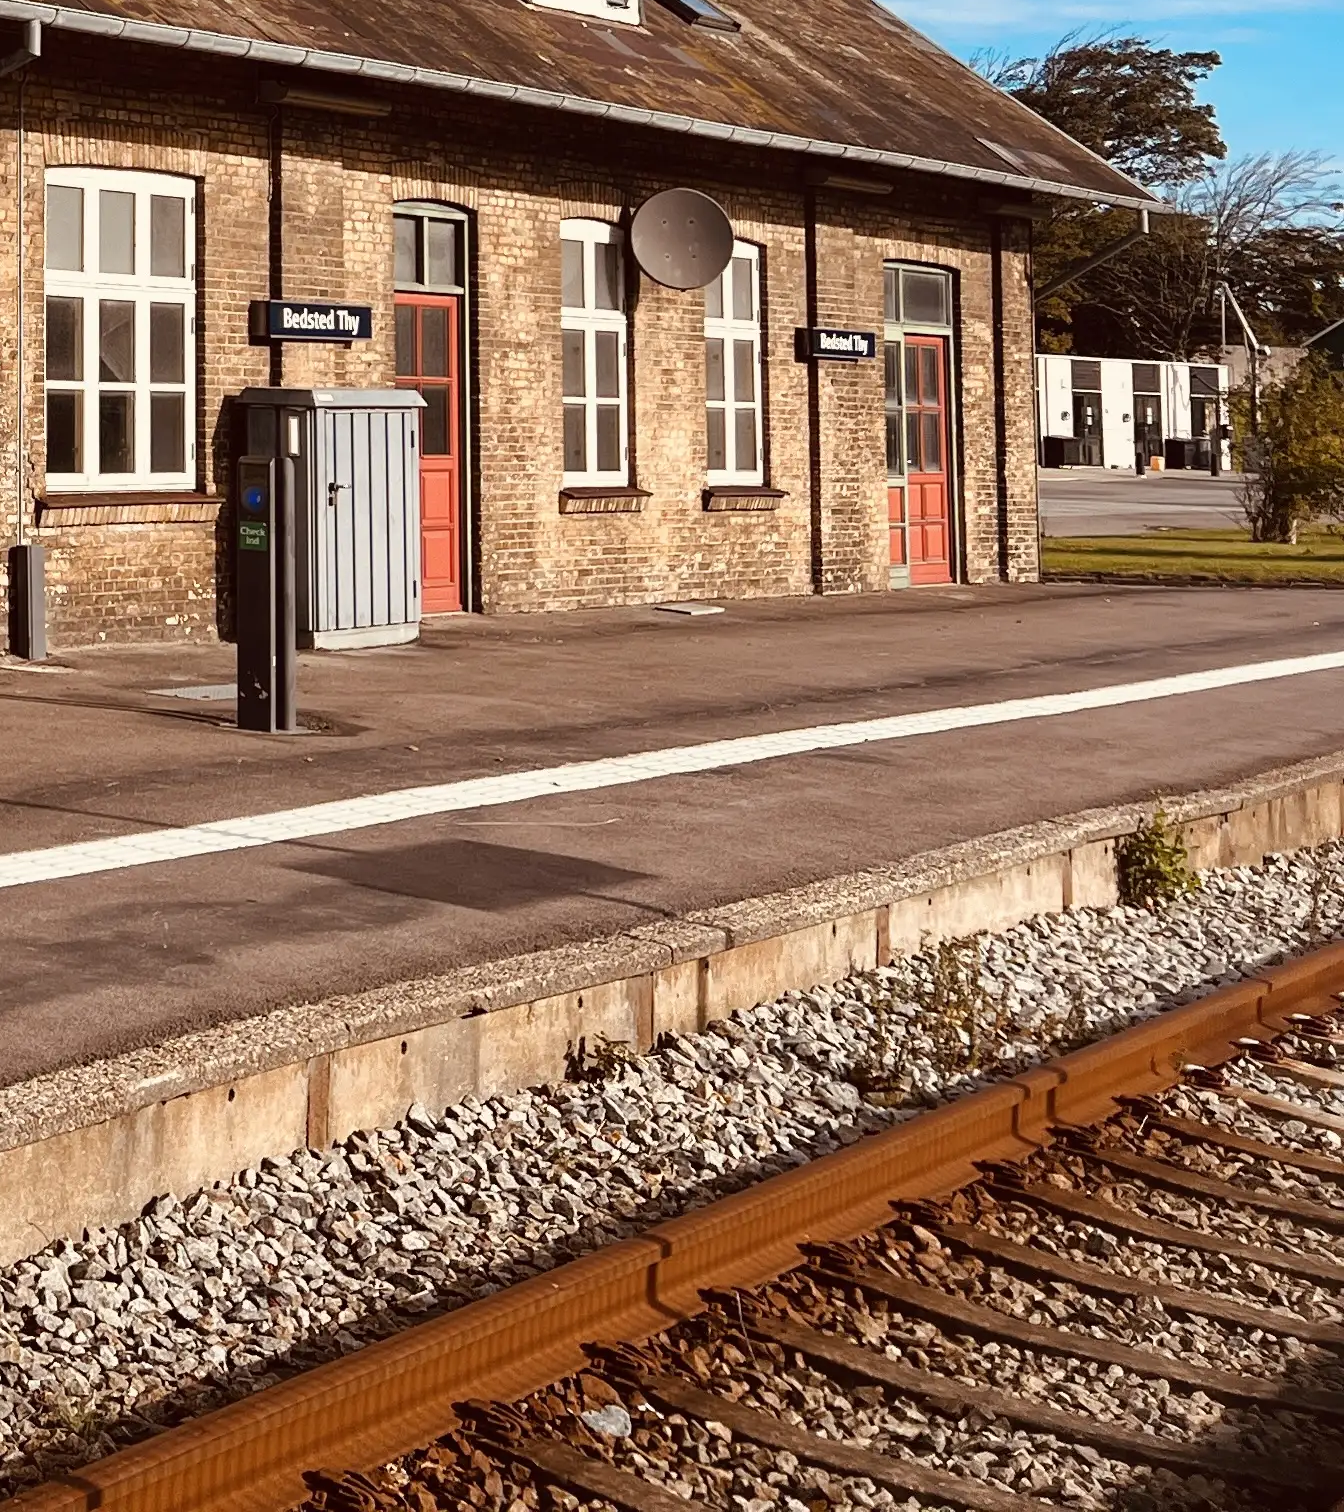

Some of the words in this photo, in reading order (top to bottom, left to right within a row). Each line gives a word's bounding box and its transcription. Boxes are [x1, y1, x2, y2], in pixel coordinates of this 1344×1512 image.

[283, 307, 335, 330] Bedsted
[336, 309, 360, 336] Thy
[820, 332, 853, 351] Bedsted
[853, 334, 869, 356] Thy
[240, 526, 266, 537] Check
